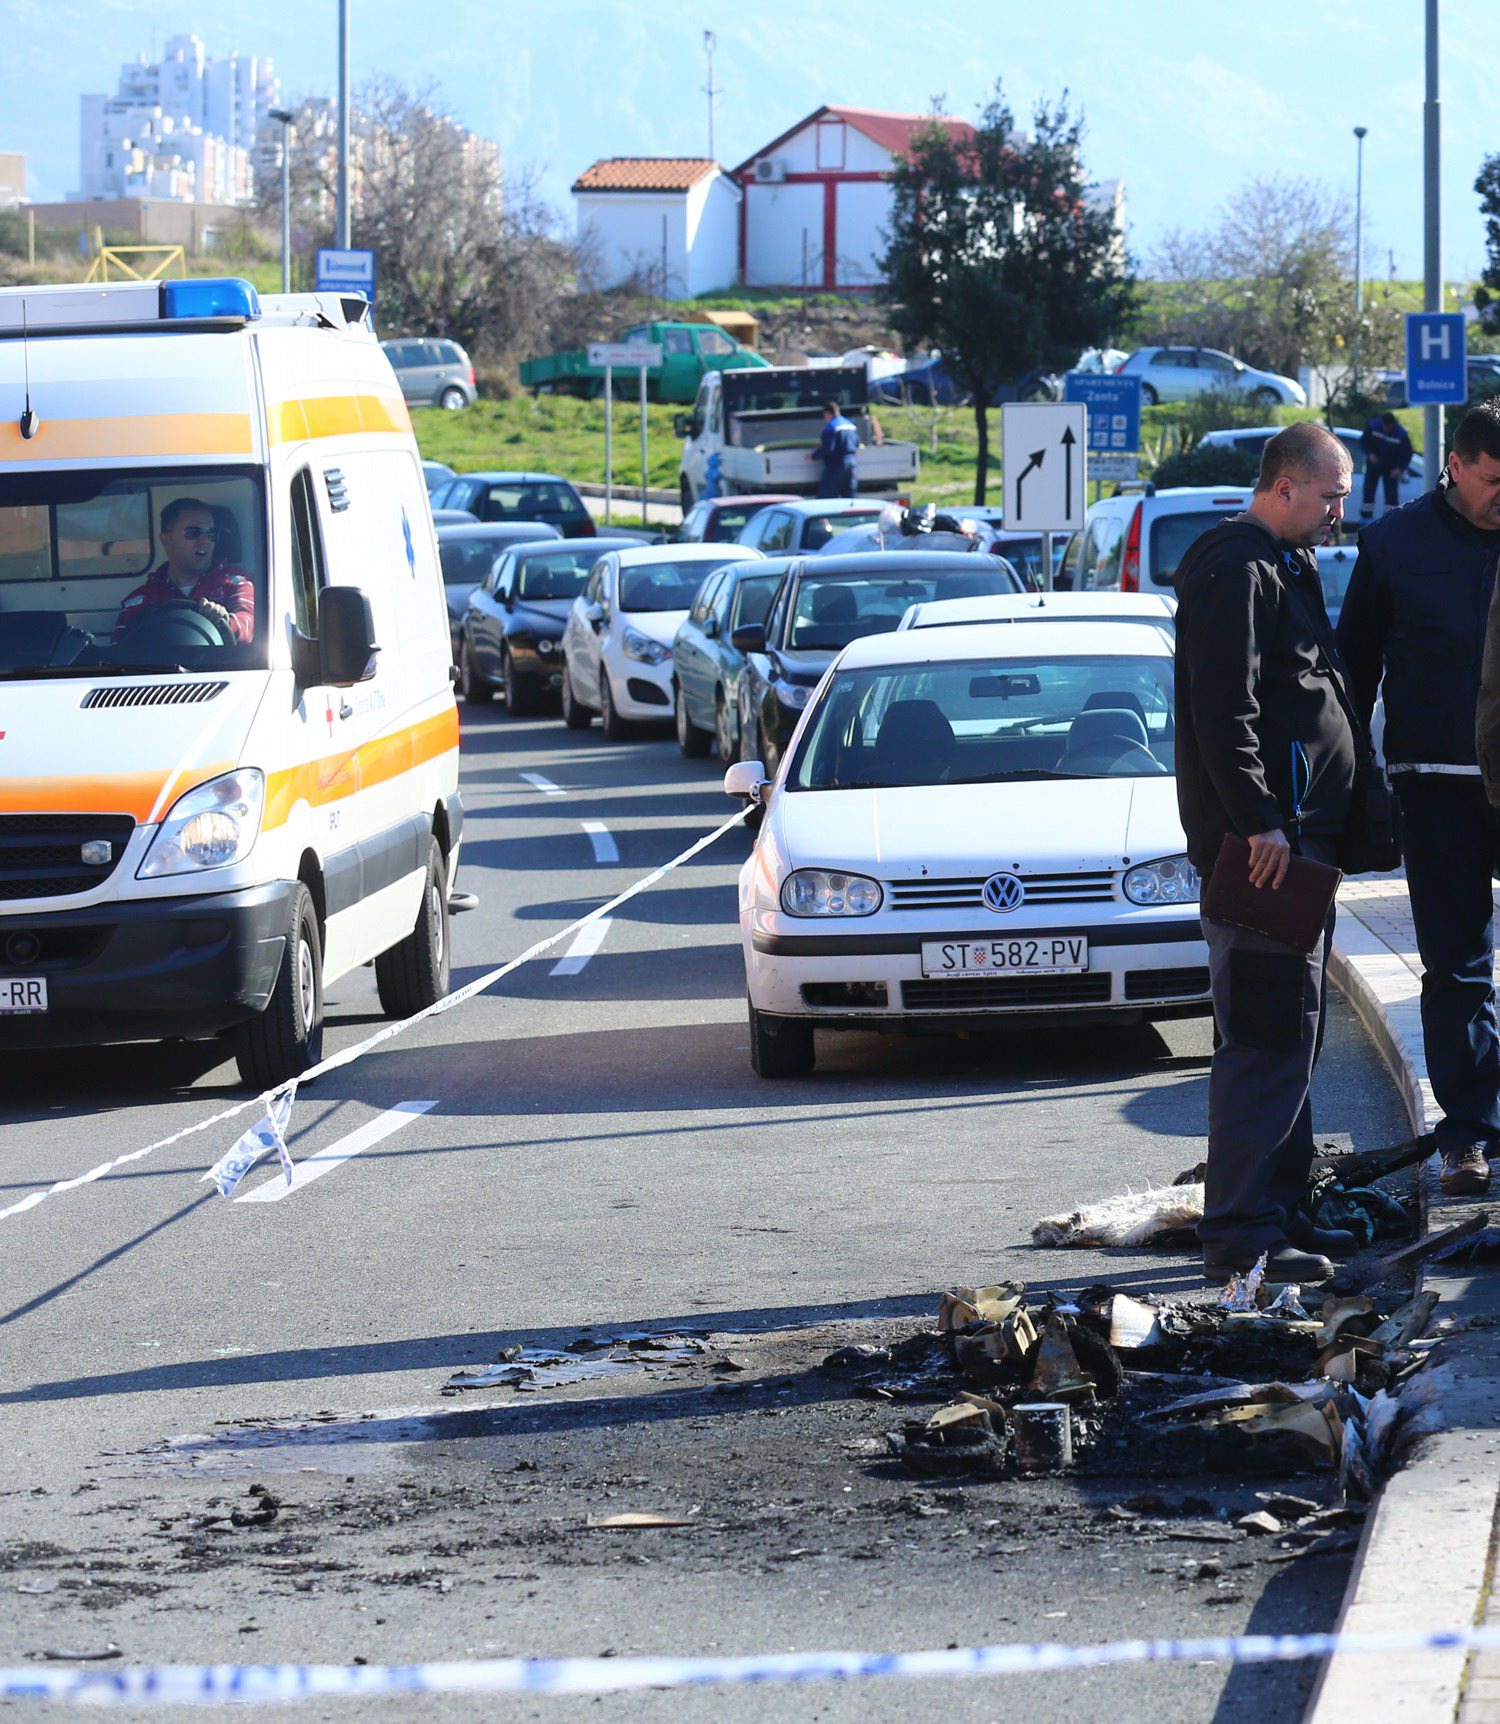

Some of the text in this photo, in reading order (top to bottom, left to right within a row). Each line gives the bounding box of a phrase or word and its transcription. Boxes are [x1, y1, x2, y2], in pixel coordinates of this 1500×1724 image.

[1421, 325, 1450, 360] H
[942, 939, 1082, 969] ST 582-PV
